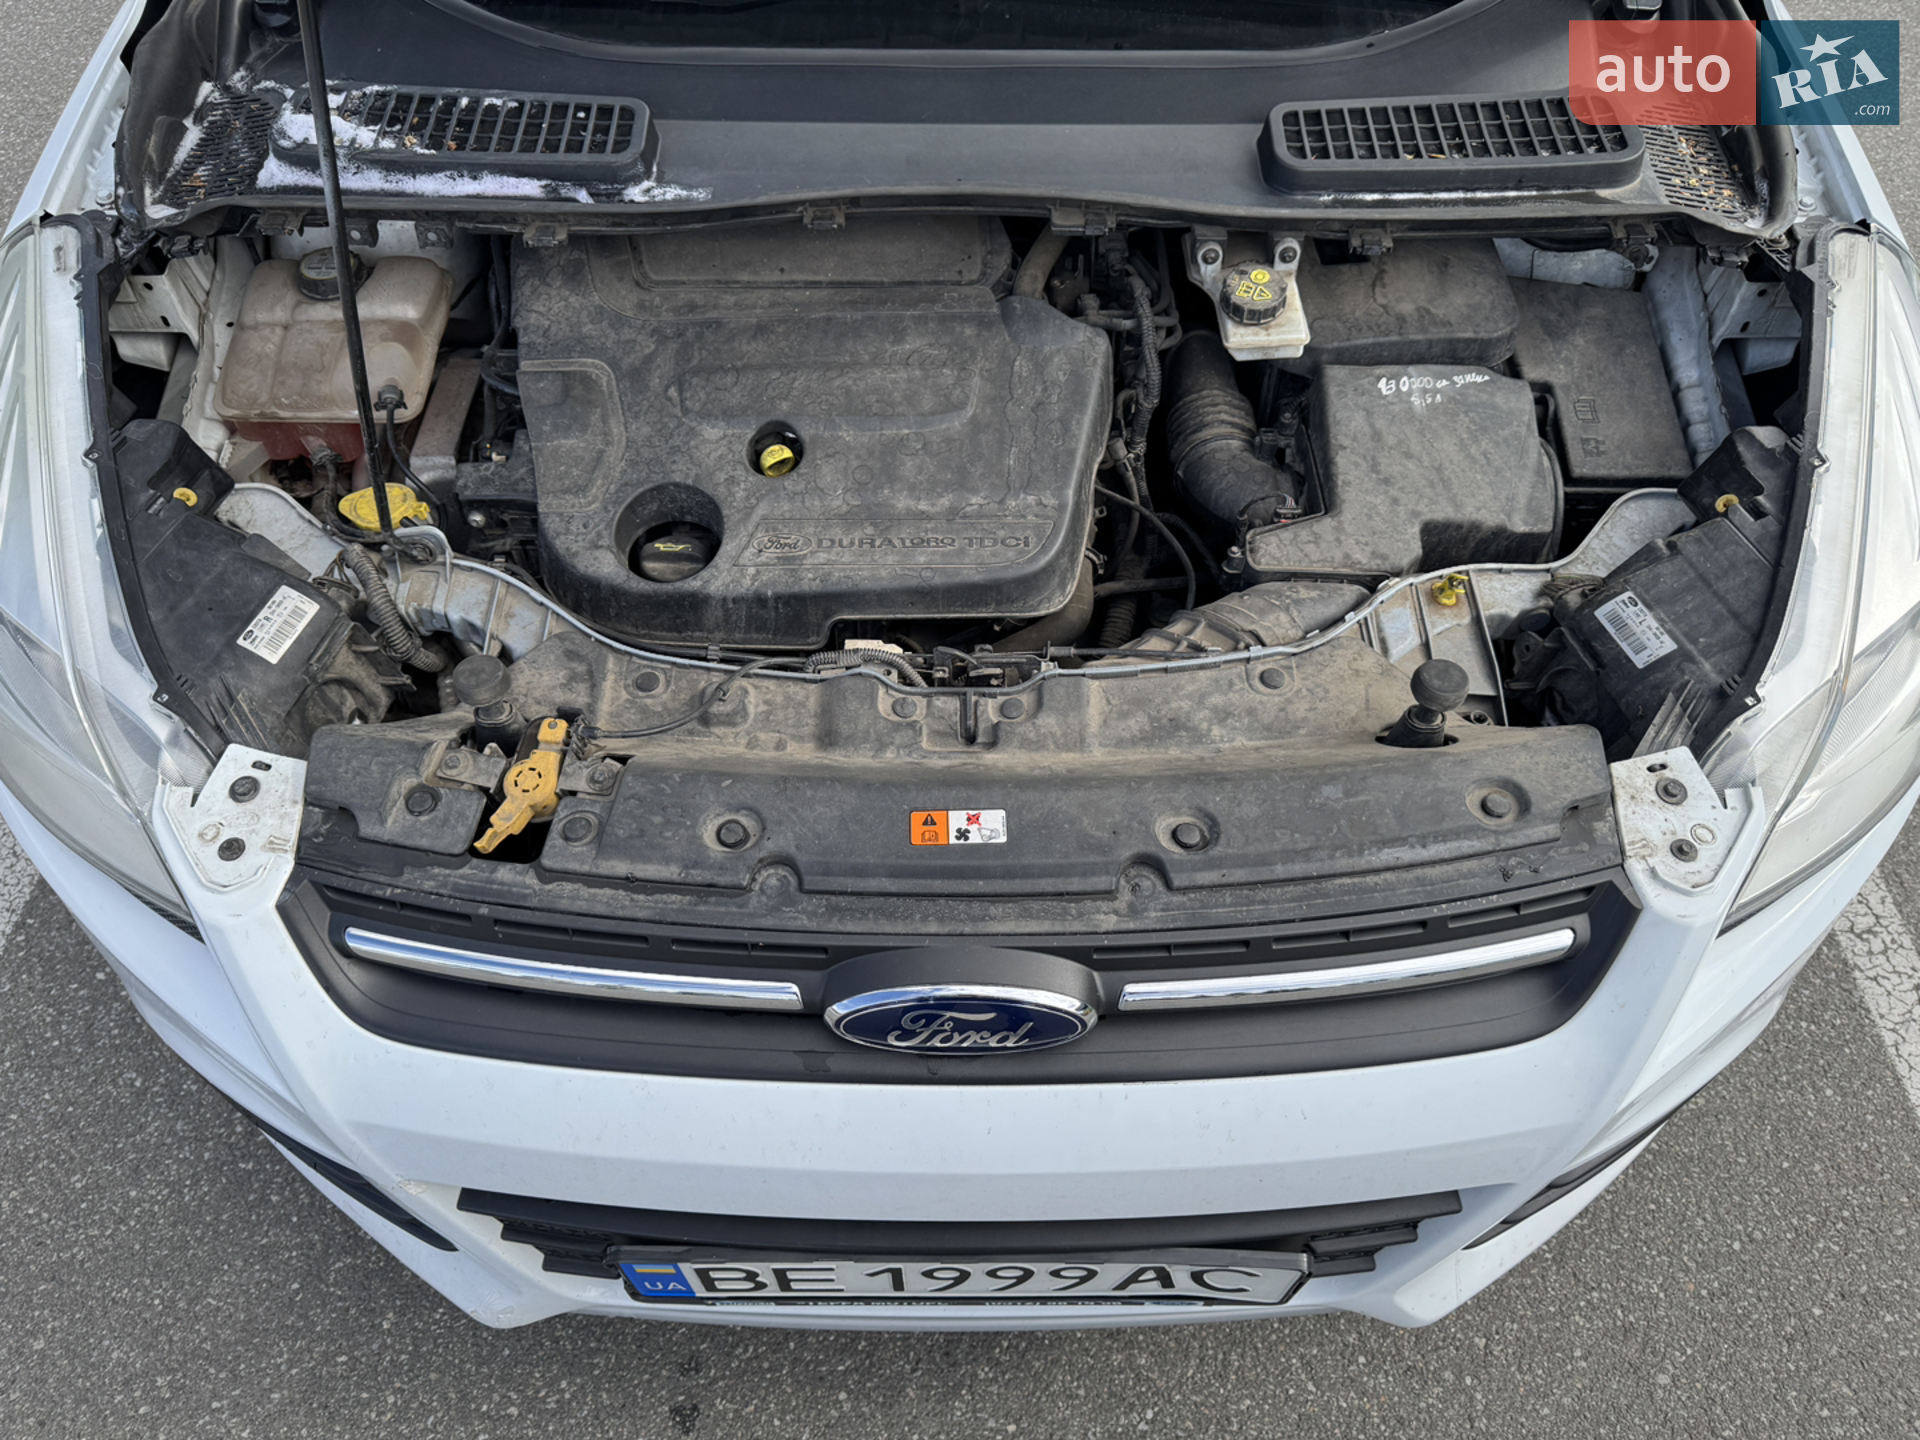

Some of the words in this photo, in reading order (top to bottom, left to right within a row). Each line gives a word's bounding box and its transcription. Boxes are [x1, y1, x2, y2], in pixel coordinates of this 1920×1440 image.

[762, 535, 801, 550] Ford
[963, 536, 1032, 549] TDCi
[887, 1009, 1034, 1047] Ford
[643, 1281, 687, 1291] UA
